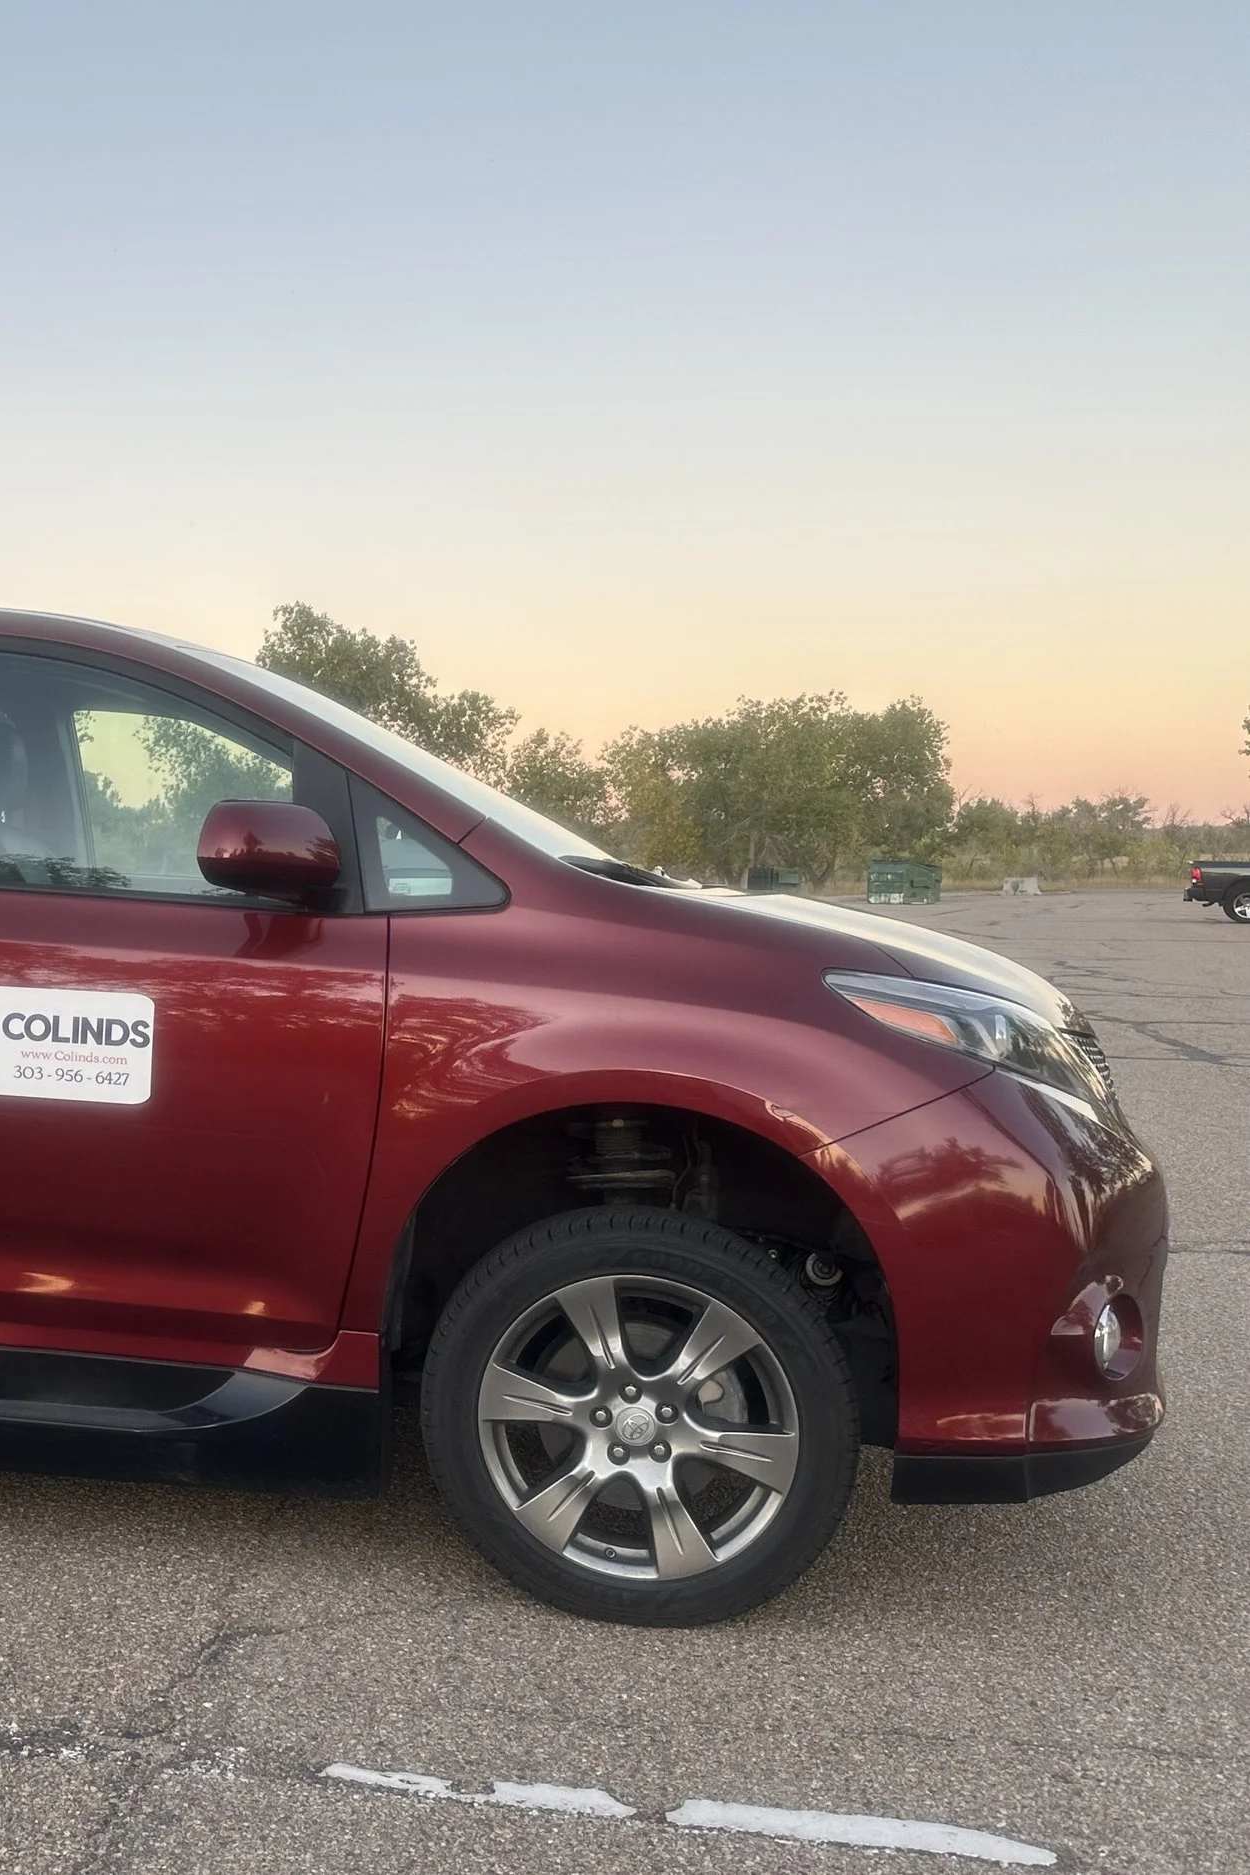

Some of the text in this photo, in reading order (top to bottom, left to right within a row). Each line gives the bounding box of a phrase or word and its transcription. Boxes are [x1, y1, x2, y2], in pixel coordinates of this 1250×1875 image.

[2, 1012, 151, 1048] COLINDS
[21, 1050, 128, 1065] www.Colinds.com
[13, 1065, 43, 1080] 303
[55, 1068, 83, 1083] 956
[95, 1071, 130, 1086] 6427
